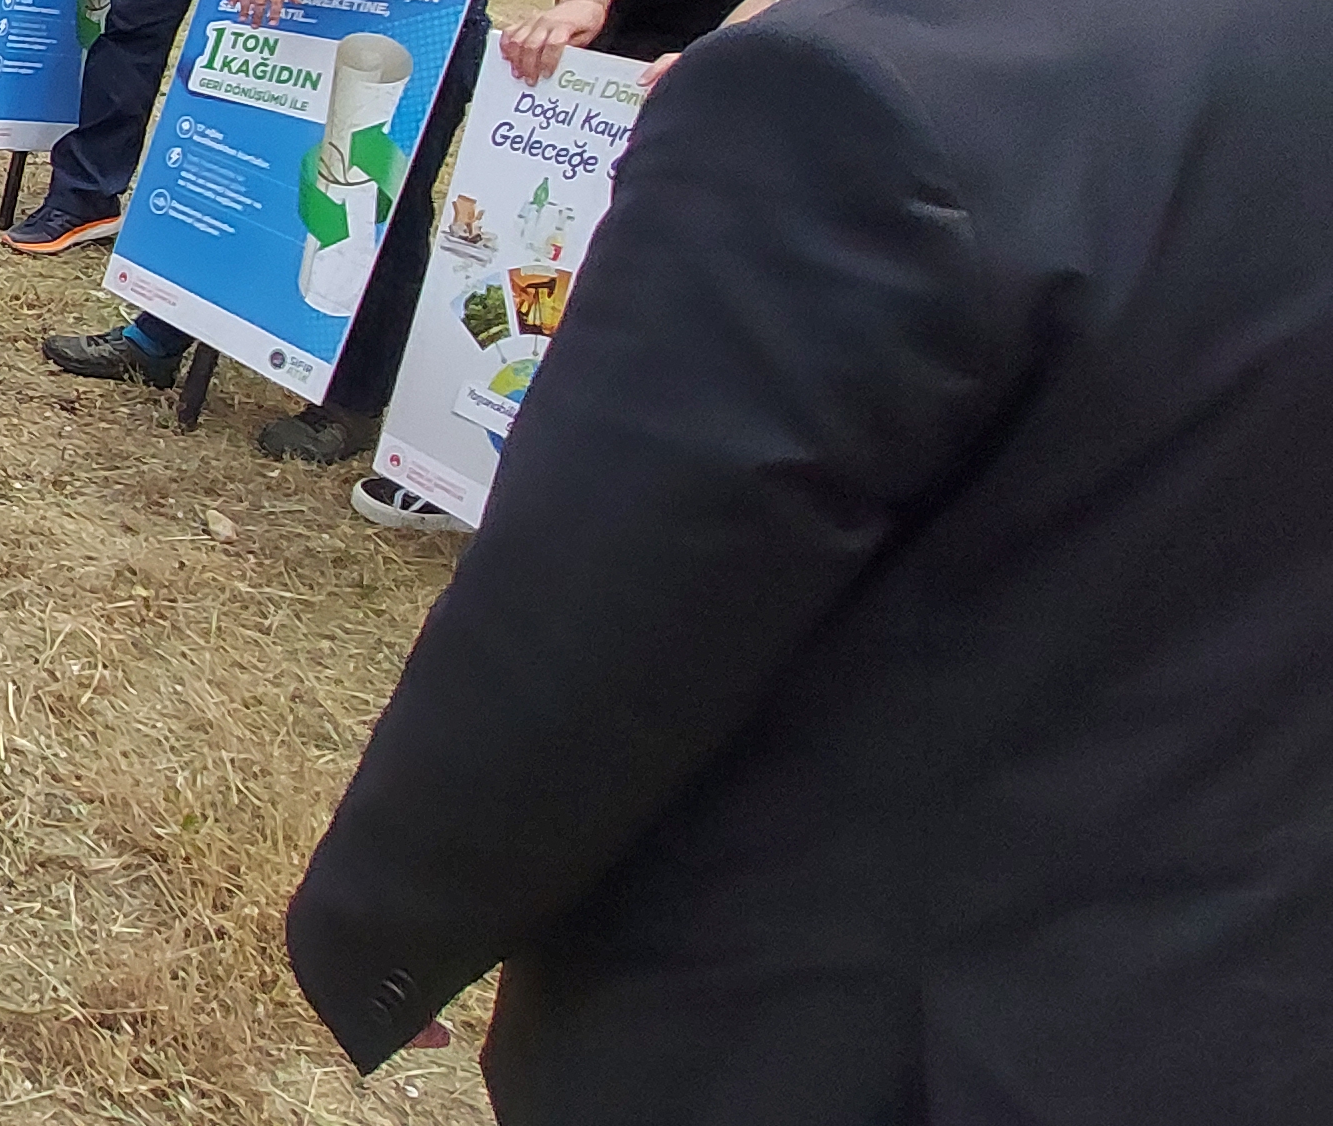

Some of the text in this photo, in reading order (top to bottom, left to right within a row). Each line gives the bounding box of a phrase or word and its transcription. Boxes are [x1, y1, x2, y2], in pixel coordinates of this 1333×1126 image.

[200, 27, 279, 71] 1 TON
[199, 77, 225, 91] GERİ
[219, 55, 323, 91] KAĞIDIN
[558, 69, 599, 96] Geri
[513, 91, 579, 130] Doğal
[491, 121, 599, 180] Geleceğe
